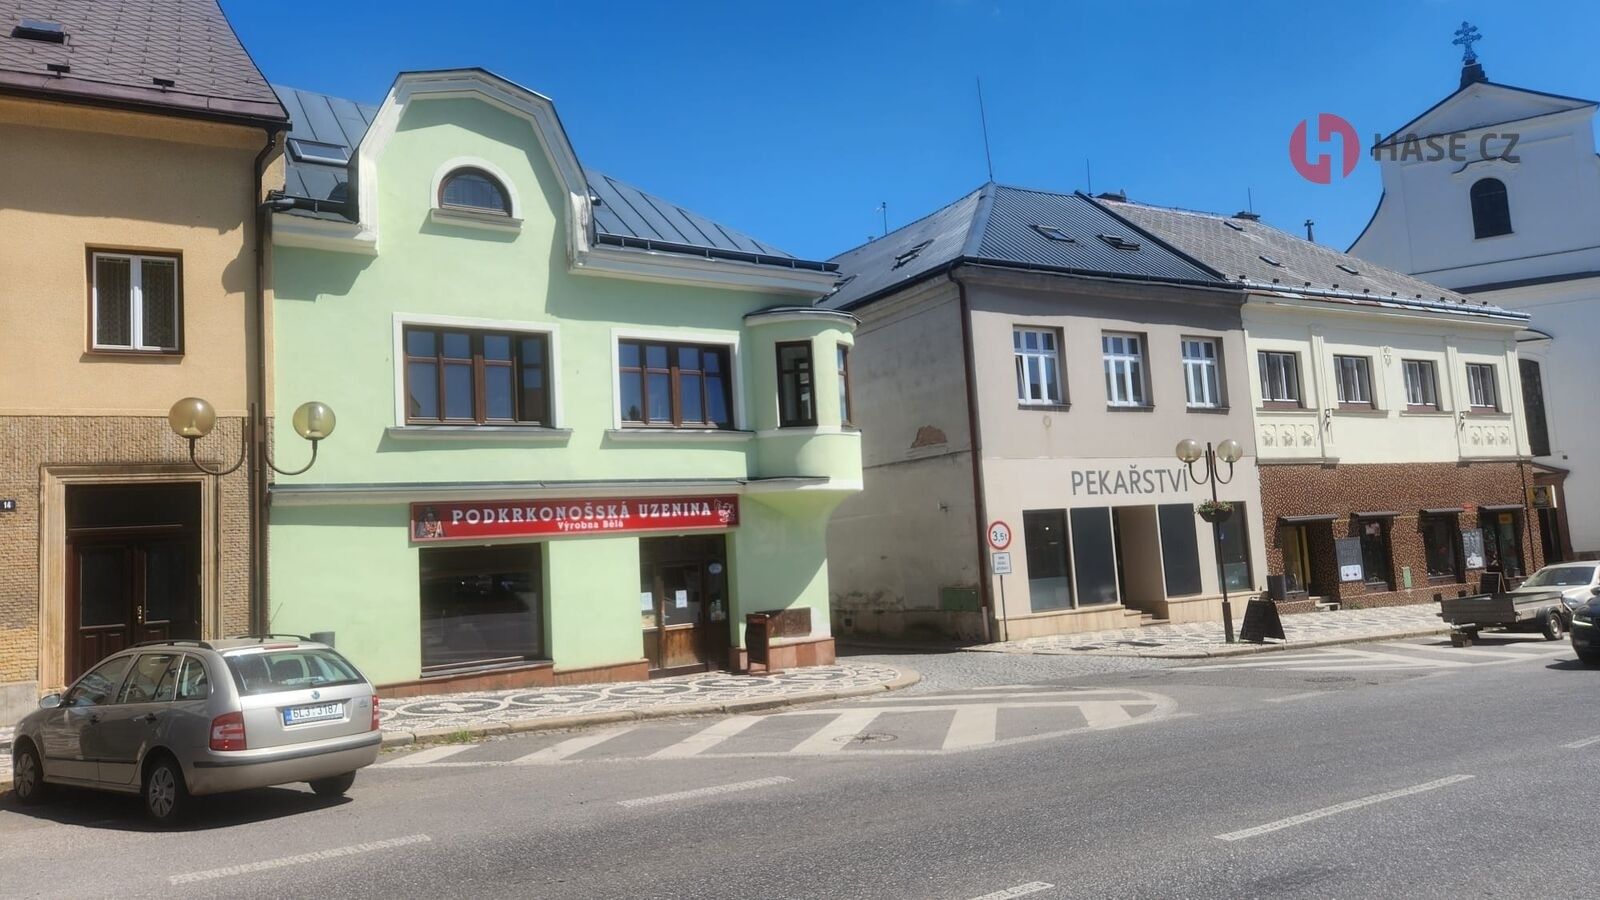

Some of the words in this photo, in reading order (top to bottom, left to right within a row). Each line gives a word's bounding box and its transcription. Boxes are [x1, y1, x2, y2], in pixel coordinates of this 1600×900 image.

[1071, 464, 1188, 495] PEKAŘSTVÍ
[452, 502, 630, 525] PODKRKONOŠSKÁ
[639, 502, 712, 518] UZENINA
[557, 520, 599, 531] Výrobna
